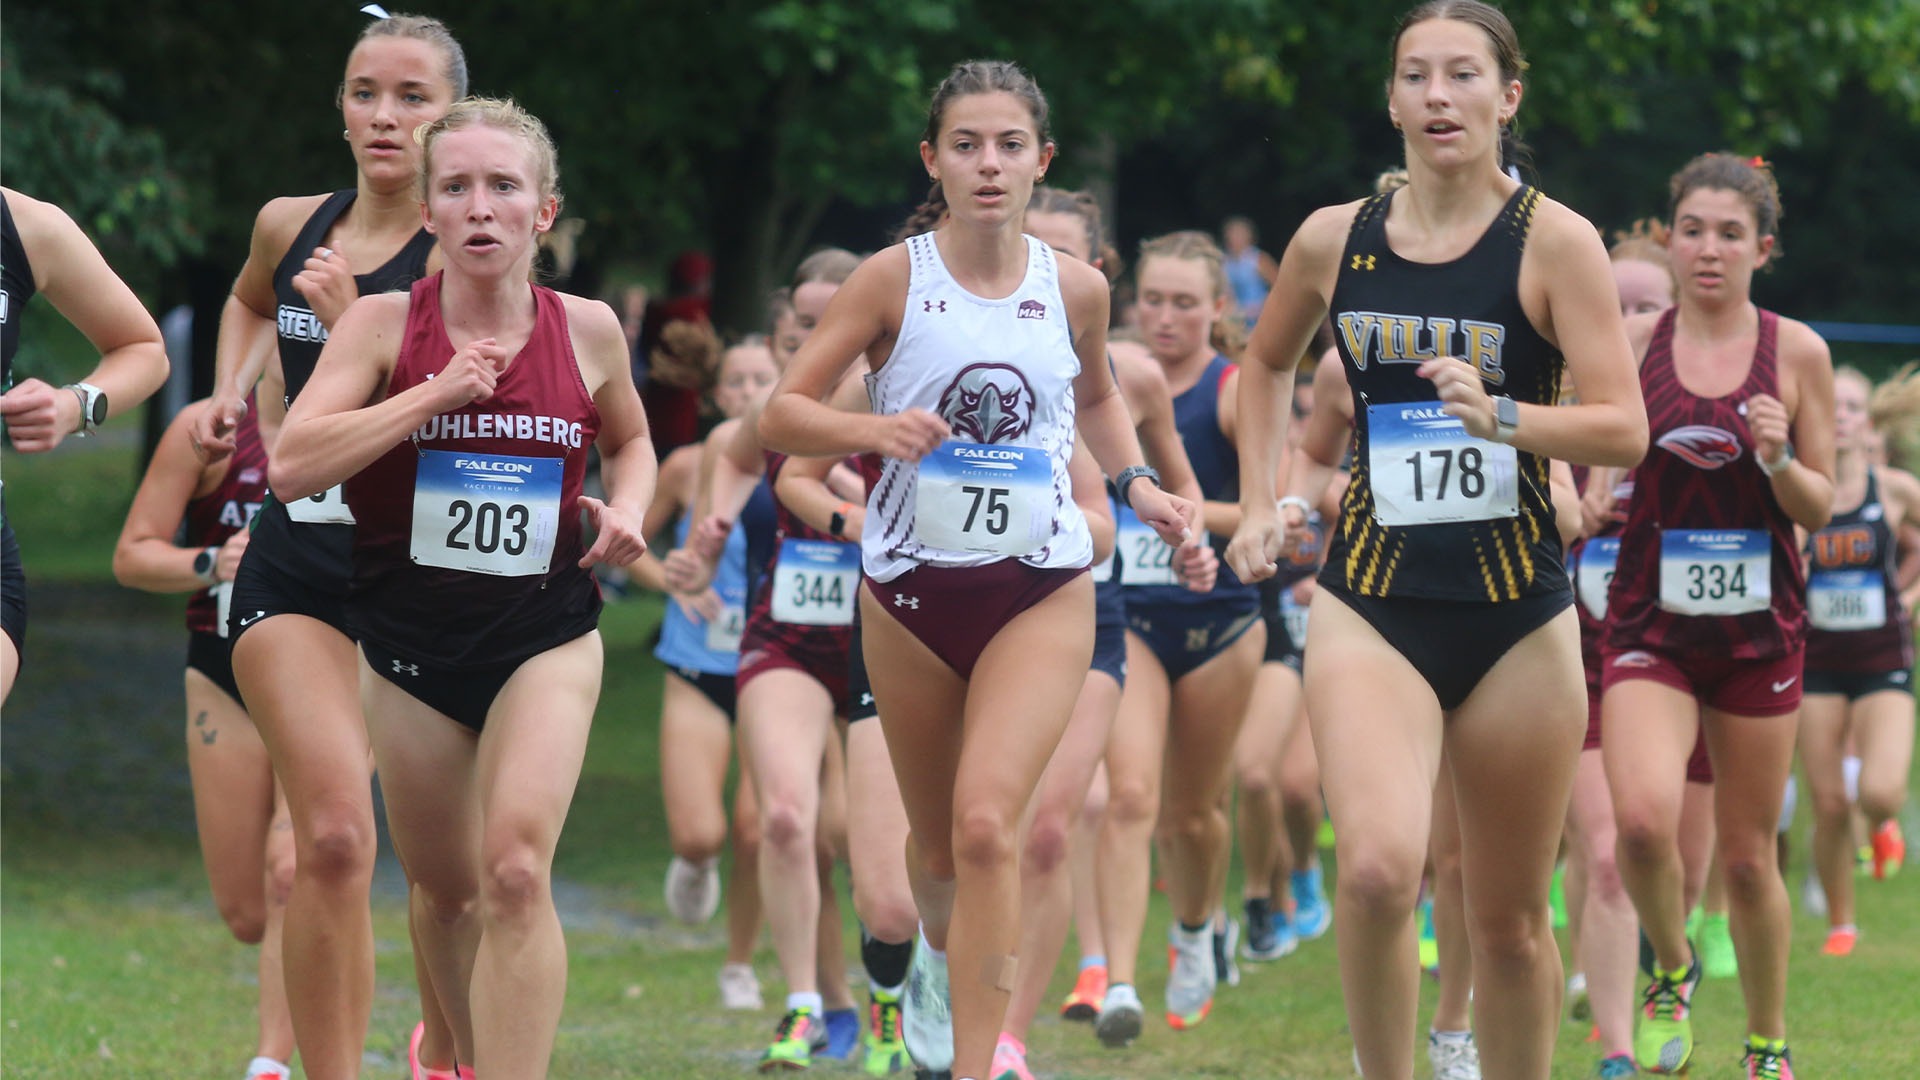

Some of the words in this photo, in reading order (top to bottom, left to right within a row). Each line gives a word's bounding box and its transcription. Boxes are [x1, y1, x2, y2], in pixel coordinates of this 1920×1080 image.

[278, 305, 330, 343] STEV
[1018, 308, 1044, 319] MAC
[1337, 311, 1505, 386] VILLE
[1401, 408, 1449, 420] FALC
[455, 459, 532, 474] FALCON
[954, 448, 1024, 460] FALCON
[464, 483, 485, 491] RACE
[488, 484, 520, 492] TIMING
[1406, 447, 1485, 502] 178
[446, 500, 529, 556] 203
[962, 486, 1009, 535] 75
[1815, 529, 1871, 567] UC
[793, 573, 845, 609] 344
[1687, 564, 1747, 600] 334
